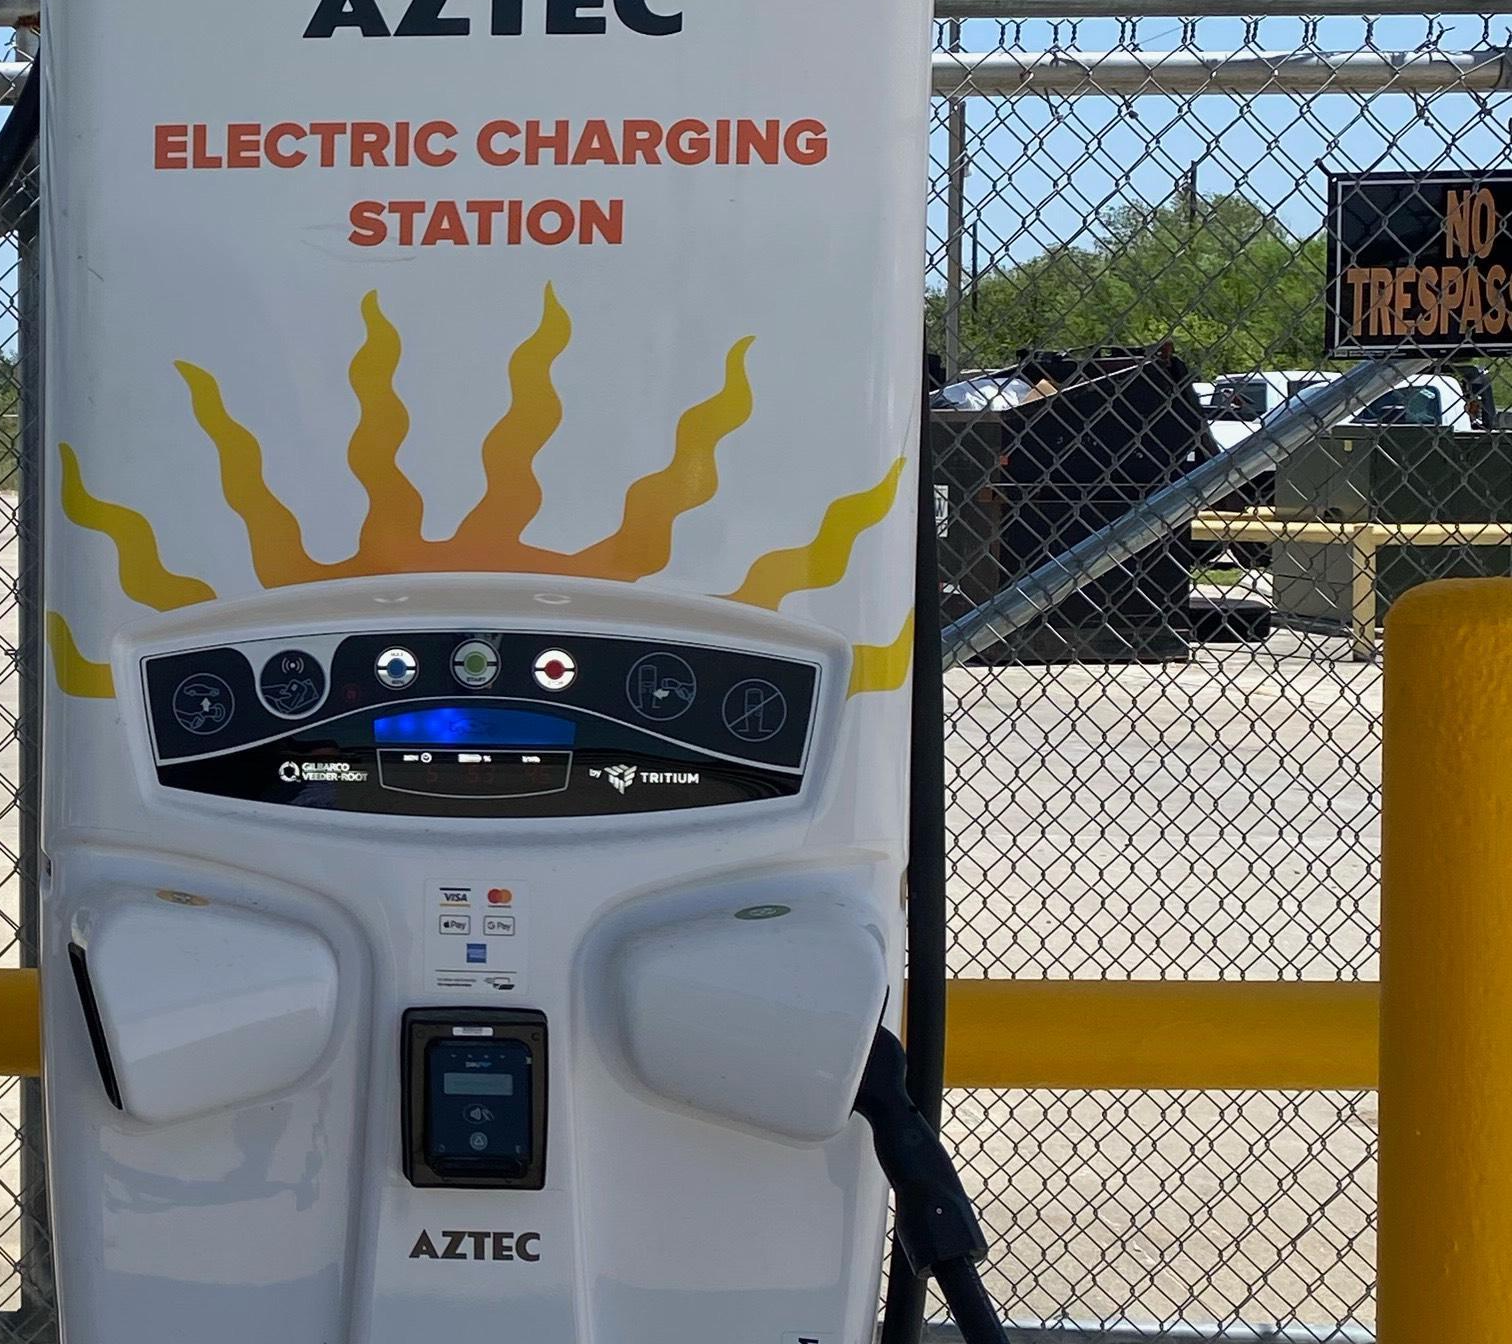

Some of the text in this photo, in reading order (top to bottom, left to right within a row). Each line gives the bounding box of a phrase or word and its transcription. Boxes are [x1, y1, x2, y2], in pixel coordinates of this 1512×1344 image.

[154, 118, 829, 170] ELECTRIC CHARGING
[348, 198, 625, 247] STATION
[1446, 187, 1496, 259] NO
[1346, 264, 1512, 337] TRESPAS
[301, 762, 350, 772] GILBARCO
[301, 771, 368, 782] VEEDER-ROOT
[589, 768, 700, 784] by TRITIUM
[444, 892, 468, 902] VISA
[450, 920, 467, 931] Pay
[497, 921, 513, 932] Pay
[409, 1229, 541, 1262] AZTEC
